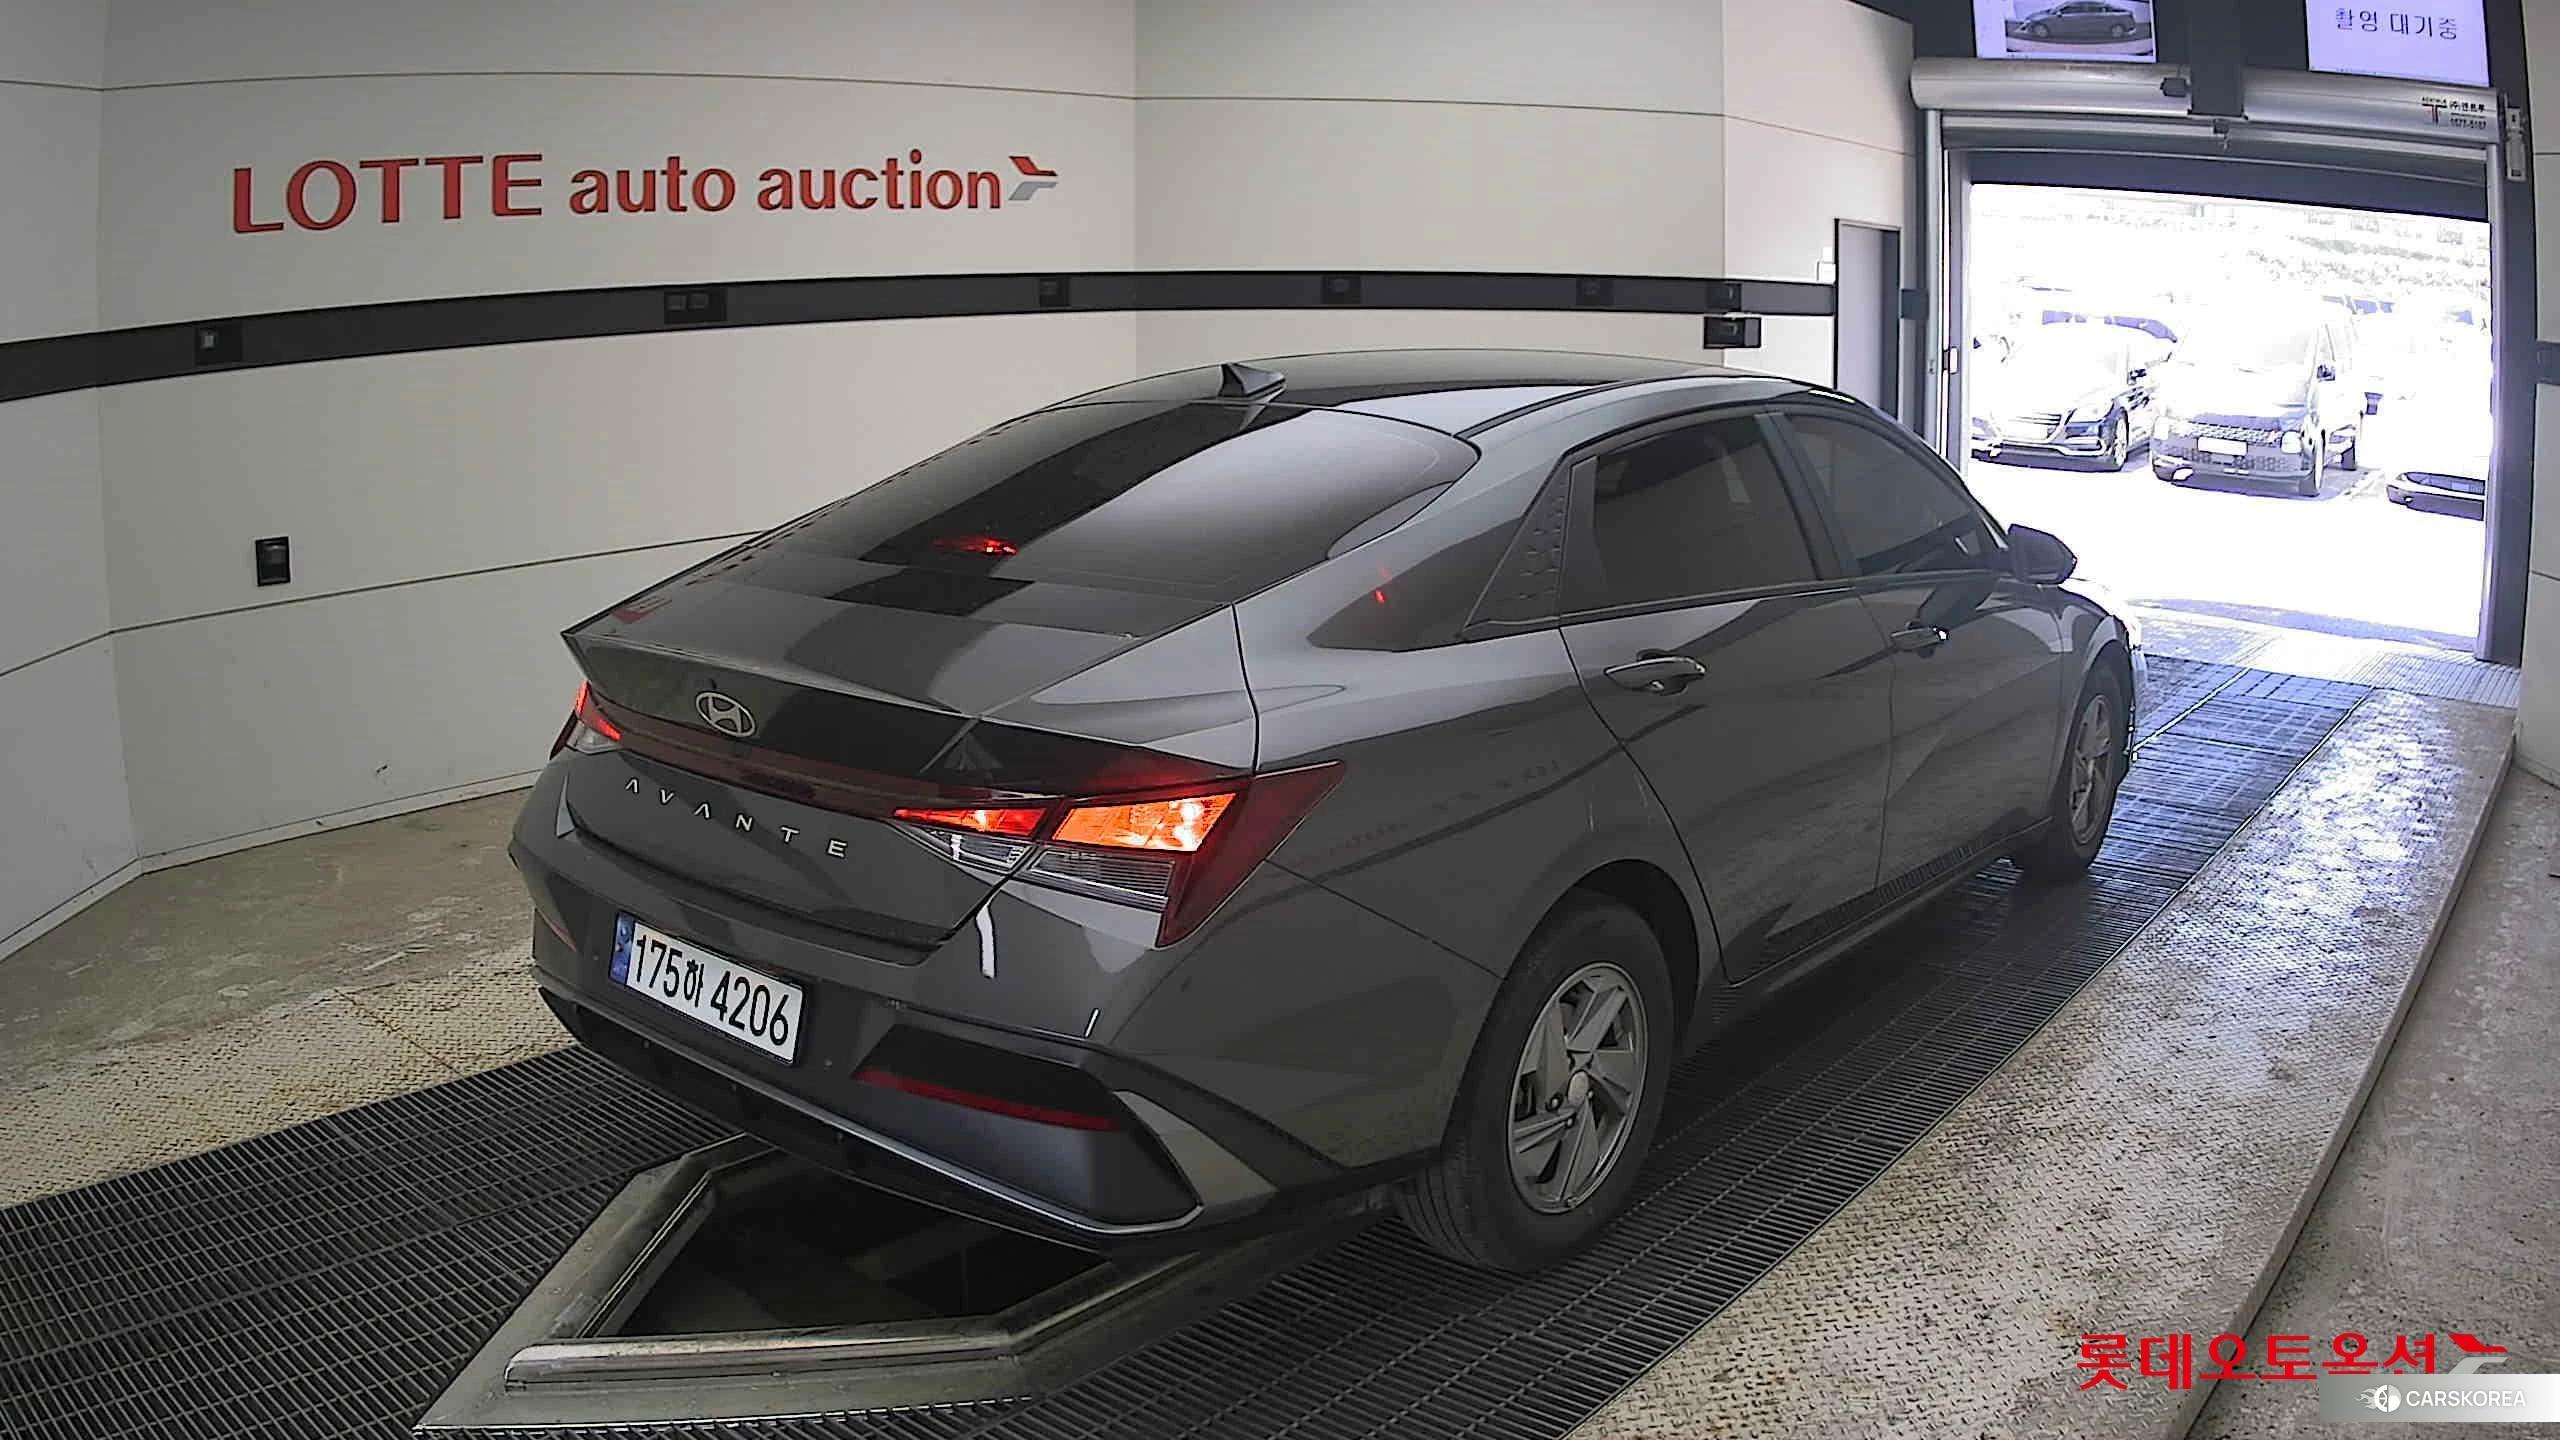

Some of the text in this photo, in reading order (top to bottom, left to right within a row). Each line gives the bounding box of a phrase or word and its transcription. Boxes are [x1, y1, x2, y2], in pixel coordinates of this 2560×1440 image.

[2390, 13, 2457, 40] 대기중
[233, 149, 1002, 233] LOTTE auto auction
[625, 778, 848, 858] AVANTE
[635, 934, 789, 1046] 175하 4206
